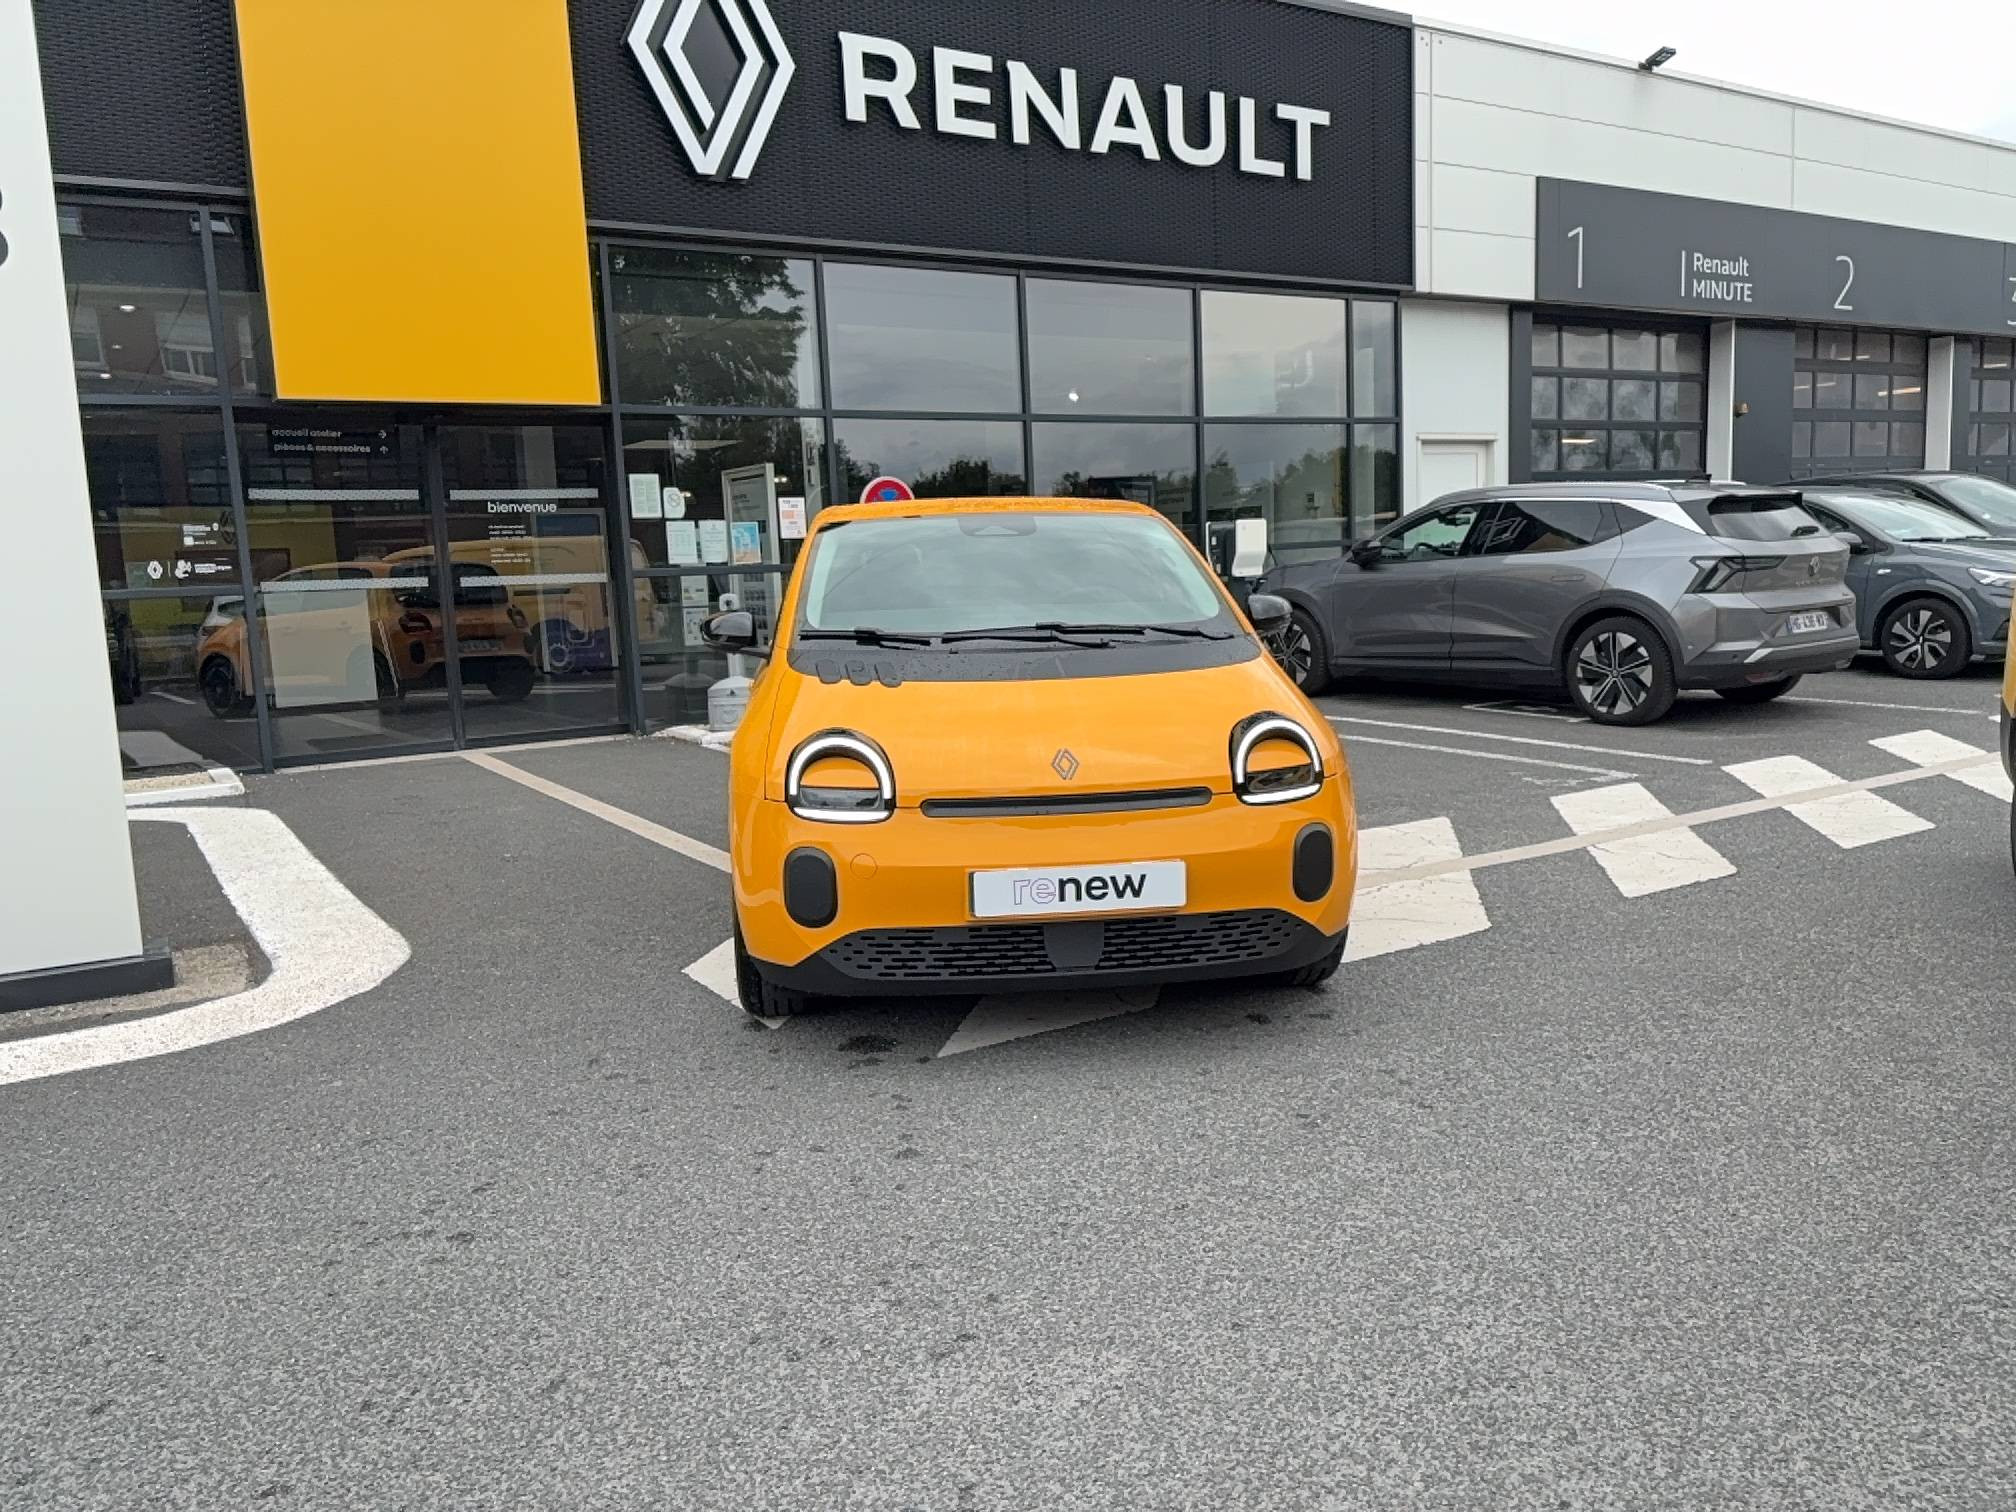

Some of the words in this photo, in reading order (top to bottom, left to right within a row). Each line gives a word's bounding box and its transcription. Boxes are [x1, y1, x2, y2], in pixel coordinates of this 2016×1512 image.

[838, 30, 1331, 181] RENAULT
[1567, 226, 1584, 289] 1
[1693, 252, 1750, 277] Renault
[1692, 278, 1753, 303] MINUTE
[1833, 254, 1855, 311] 2
[487, 501, 557, 513] bienvenue
[1012, 873, 1147, 906] renew
